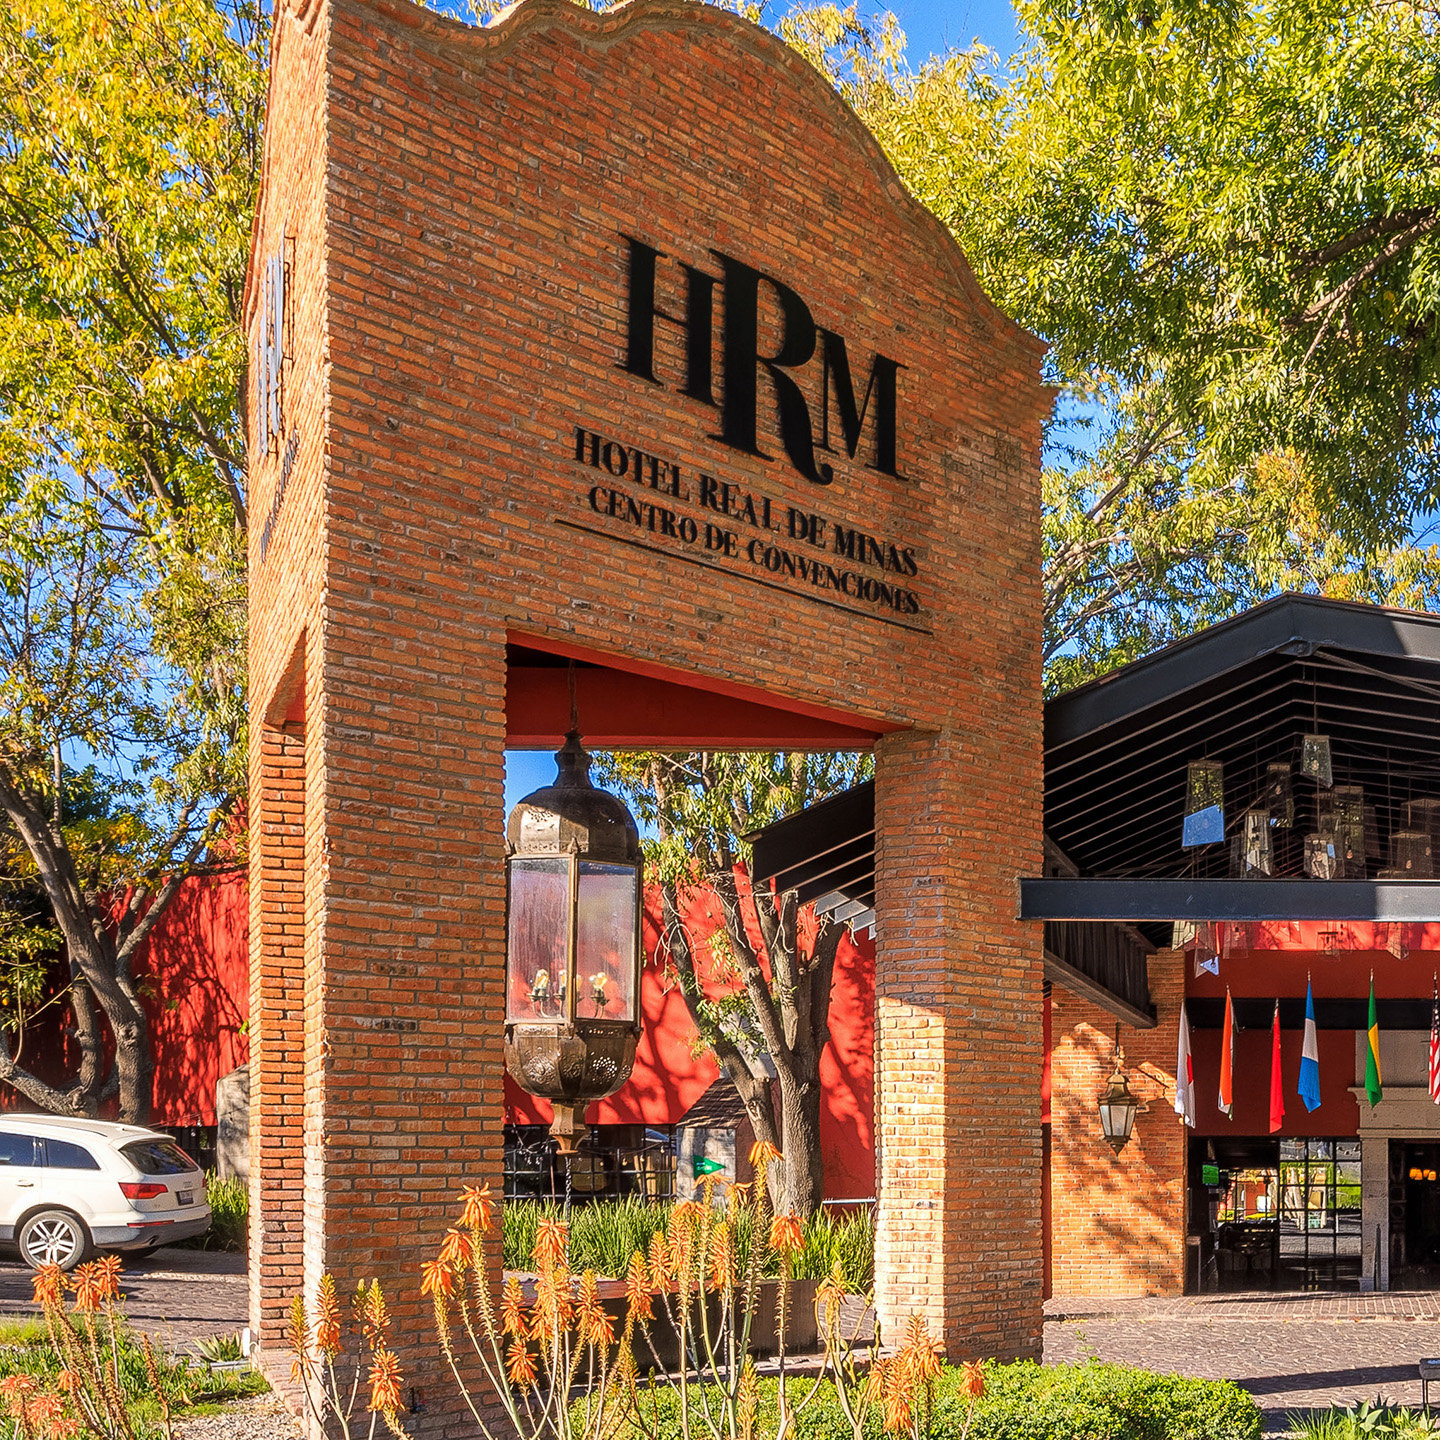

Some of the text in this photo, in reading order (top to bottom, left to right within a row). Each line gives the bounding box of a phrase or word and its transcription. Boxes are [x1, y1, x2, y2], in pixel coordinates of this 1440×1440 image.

[617, 232, 910, 485] HRM
[573, 425, 919, 577] HOTEL REAL DE MINAS
[588, 486, 920, 615] CENTRO DE CONVENCIONES
